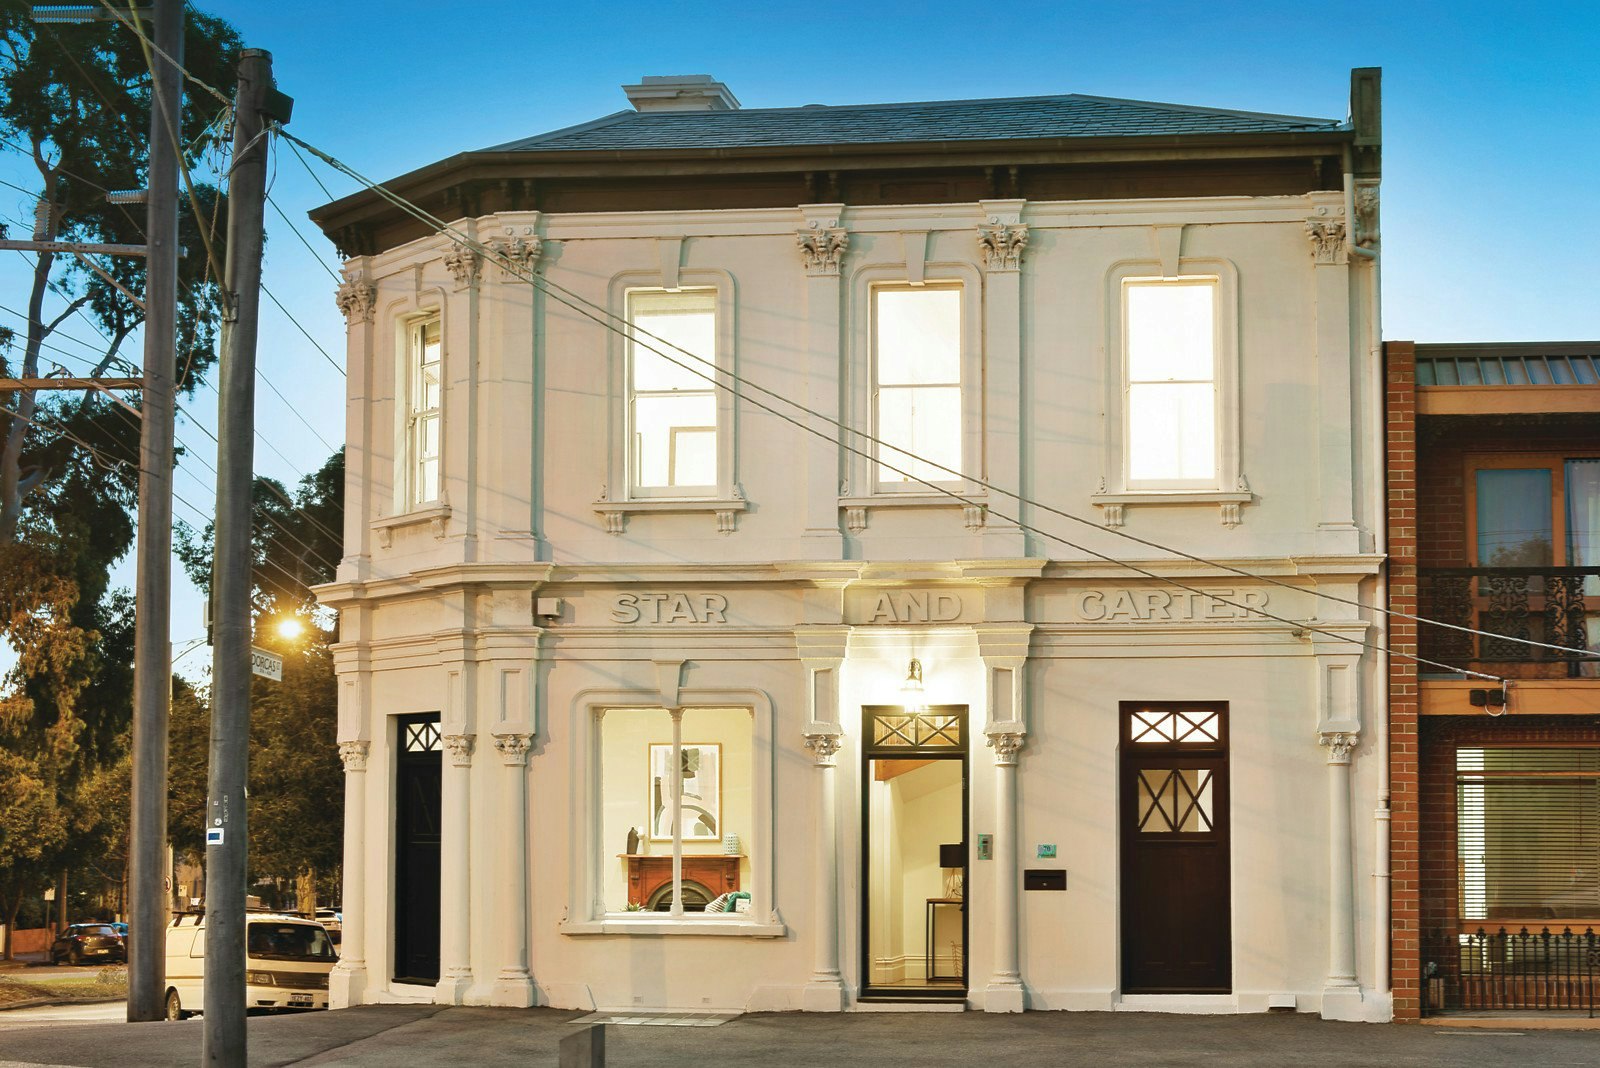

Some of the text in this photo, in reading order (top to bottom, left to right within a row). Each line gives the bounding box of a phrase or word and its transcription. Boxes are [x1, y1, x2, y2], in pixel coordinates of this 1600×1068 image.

[609, 588, 1270, 624] STAR AND GARTER
